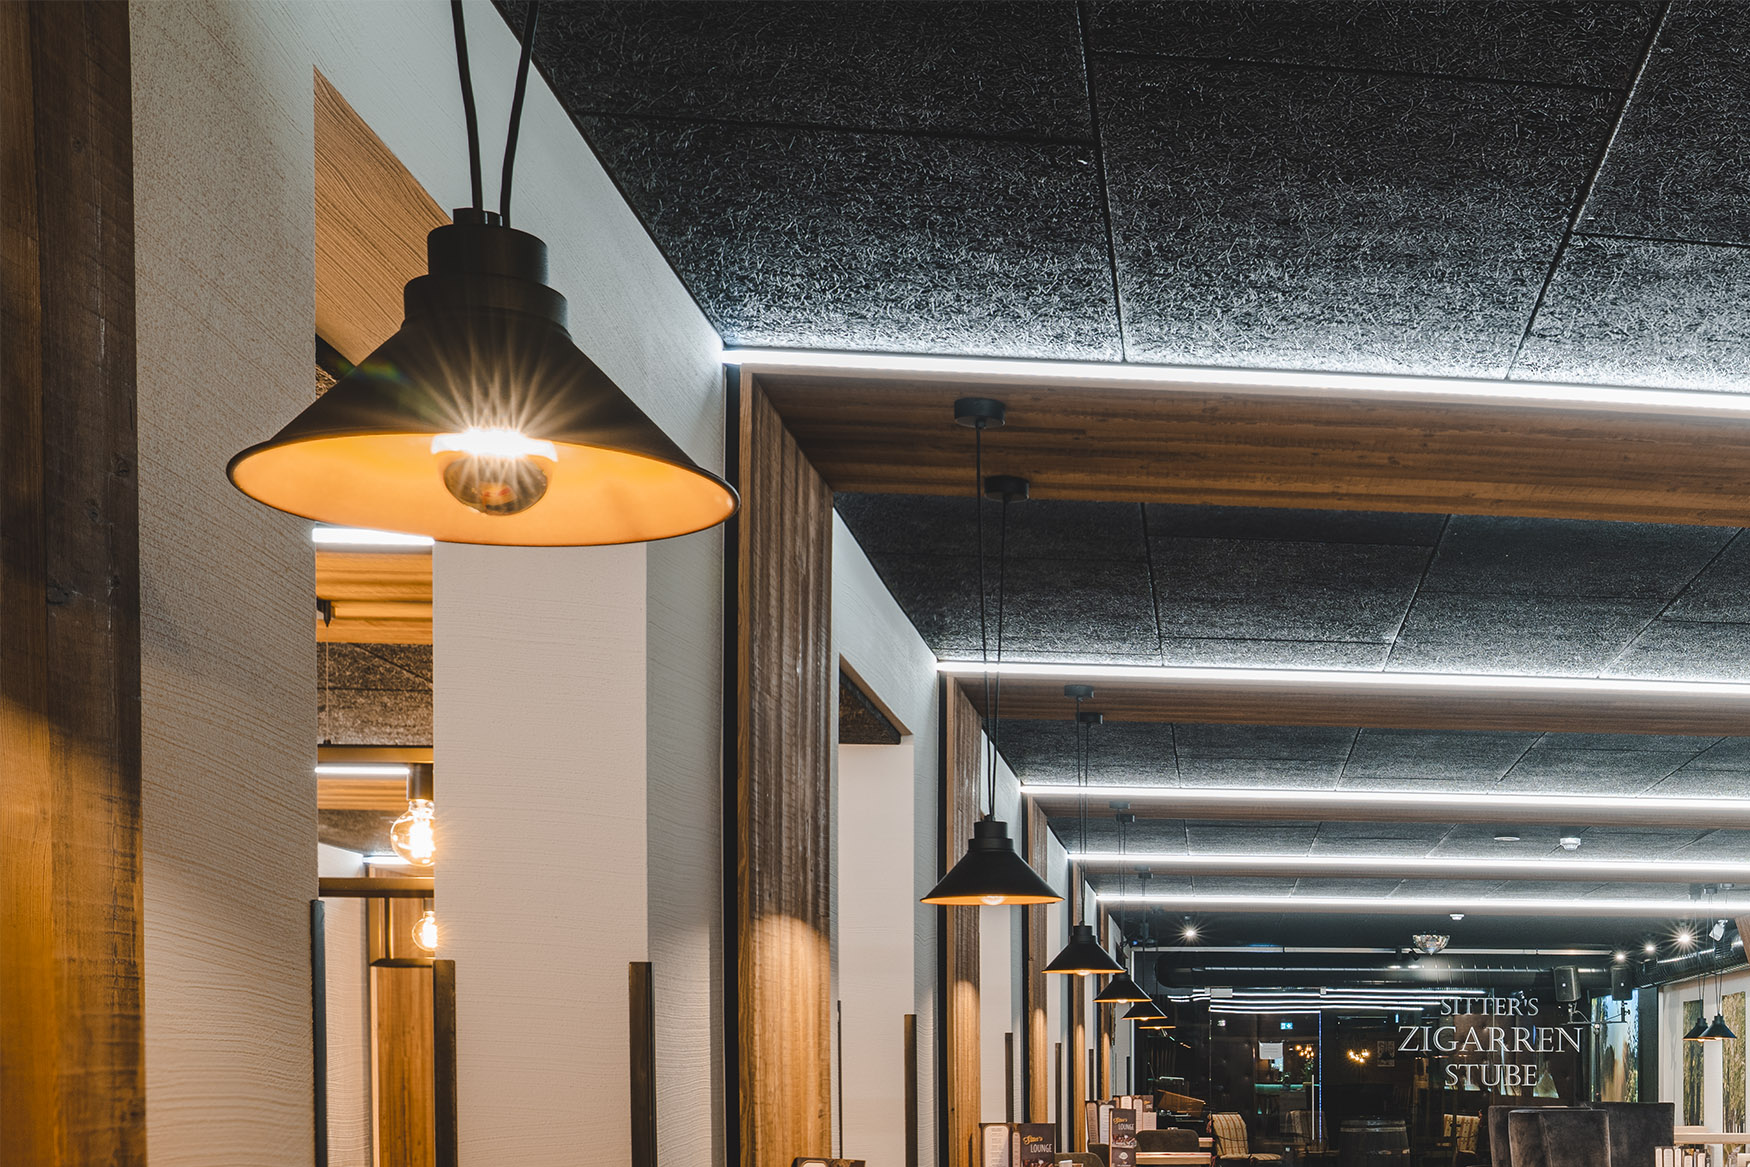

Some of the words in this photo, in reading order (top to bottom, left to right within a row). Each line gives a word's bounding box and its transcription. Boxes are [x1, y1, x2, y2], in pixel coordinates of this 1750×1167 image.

[1440, 997, 1539, 1017] SITTER'S
[1397, 1026, 1584, 1053] ZIGARREN
[1444, 1063, 1538, 1087] STUBE
[1030, 1143, 1053, 1153] LOUNGE
